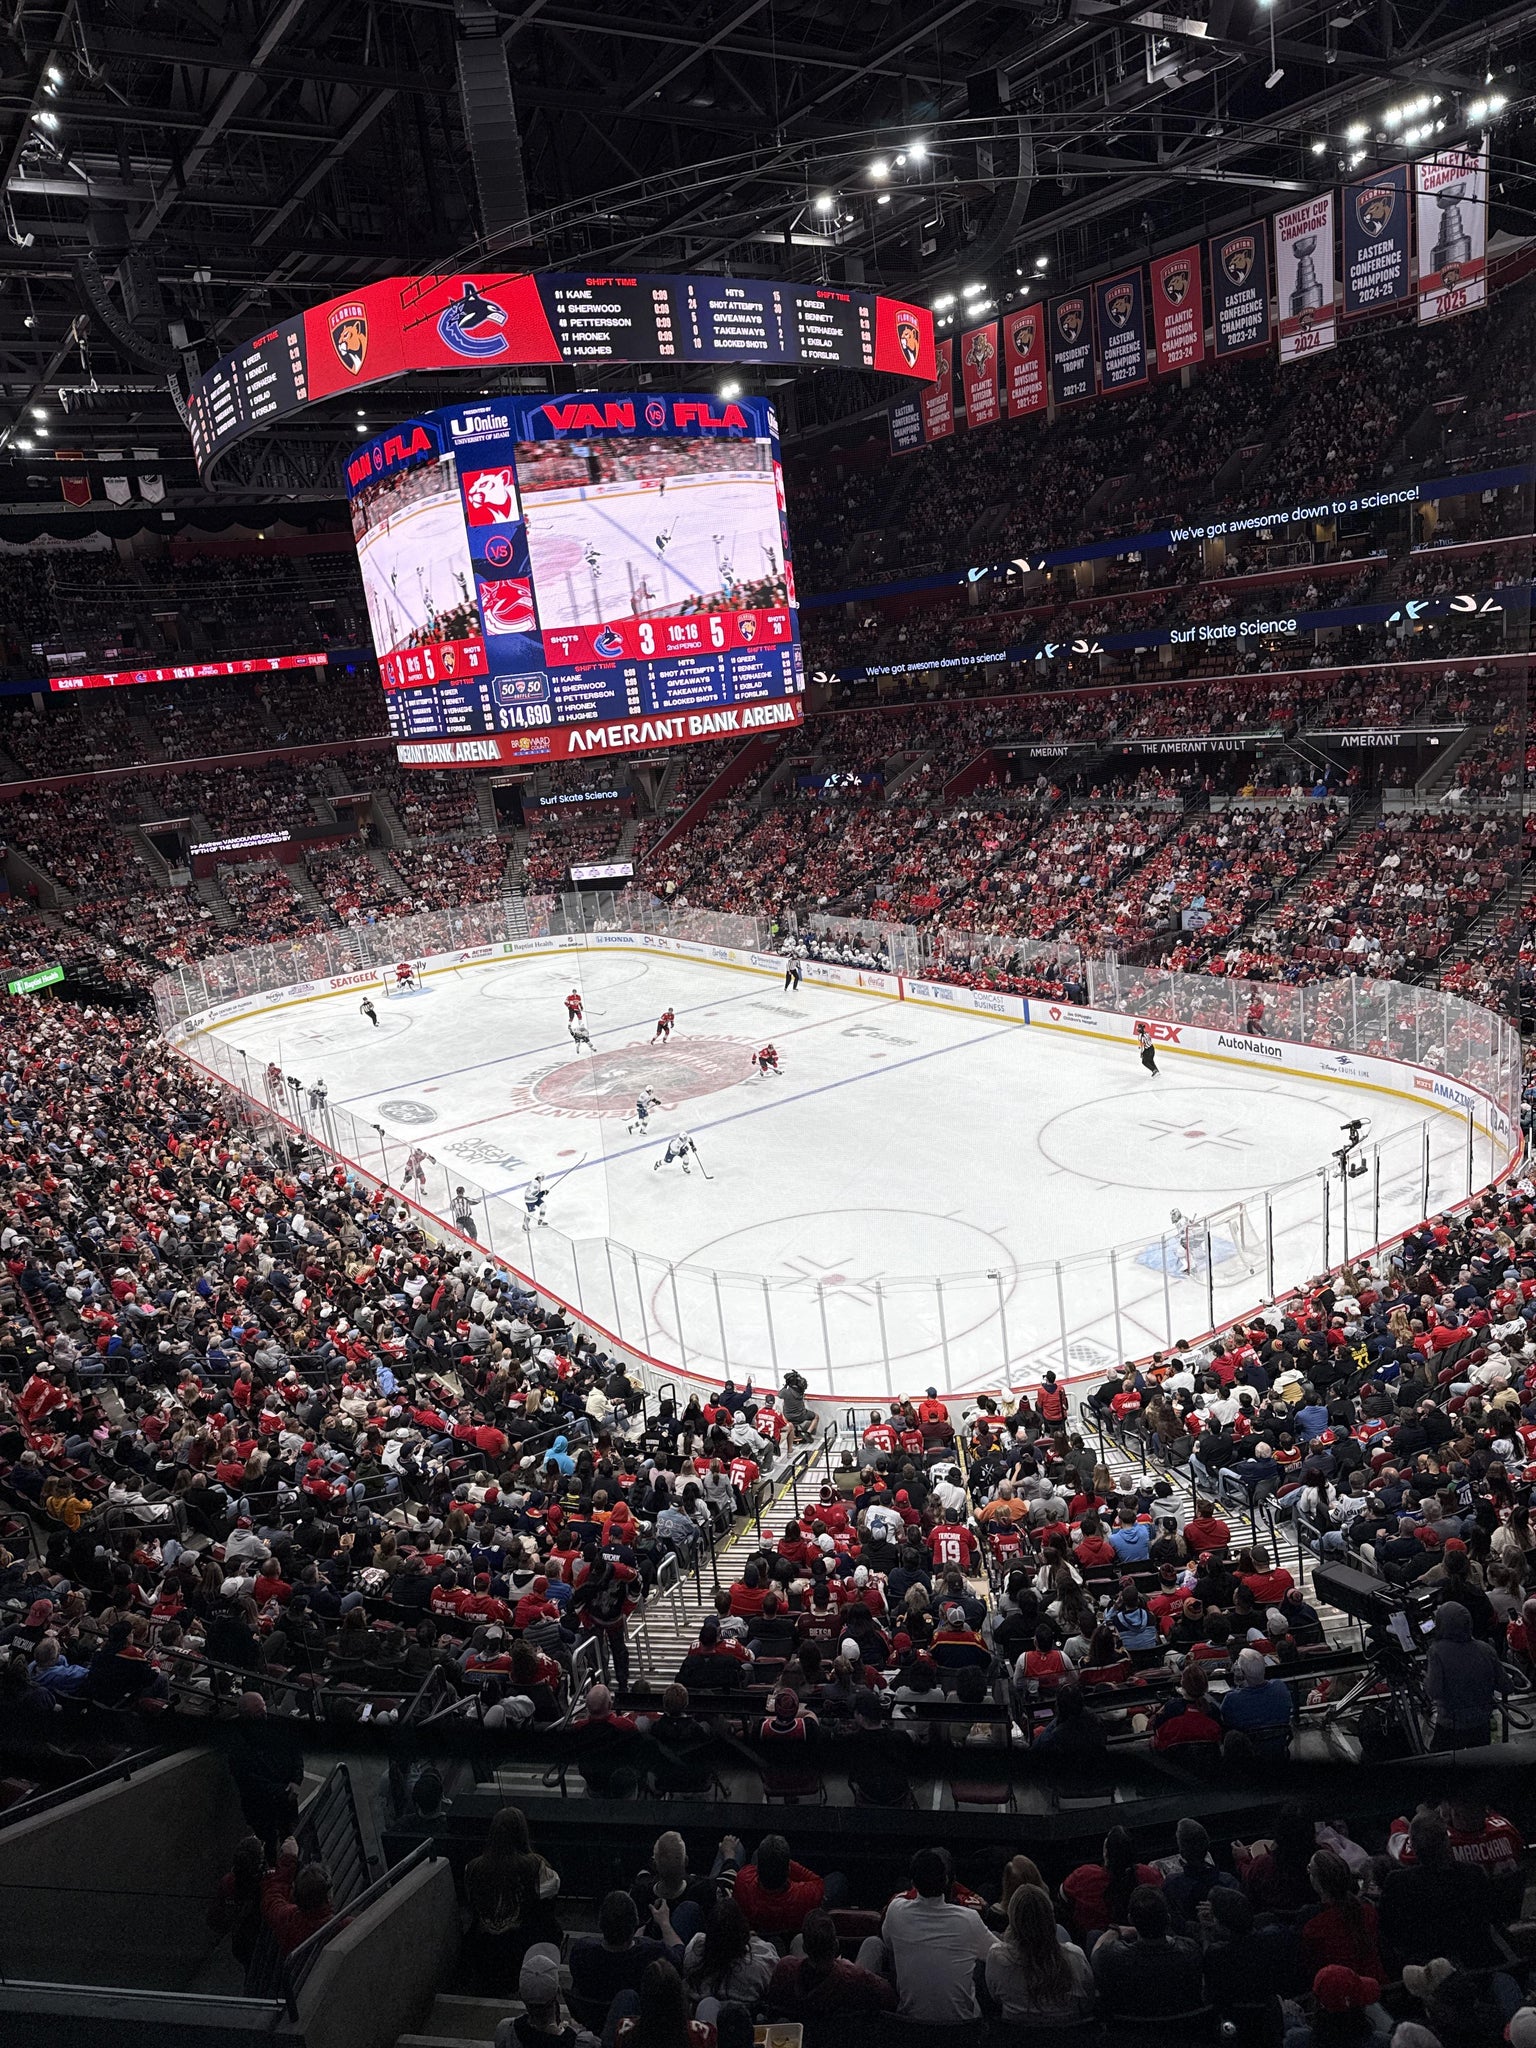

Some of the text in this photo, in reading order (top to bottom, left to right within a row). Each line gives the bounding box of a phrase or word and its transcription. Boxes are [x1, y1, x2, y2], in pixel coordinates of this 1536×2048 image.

[1279, 200, 1329, 229] STANLEY CUP
[1281, 214, 1327, 241] CHAMPIONS
[1357, 239, 1394, 262] EASTERN
[1350, 250, 1402, 278] CONFERENCE
[585, 278, 638, 287] SHIFT TIME
[1351, 265, 1401, 291] CHAMPIONS
[566, 290, 592, 299] KANE
[725, 288, 745, 298] HITS
[1225, 288, 1256, 308] EASTERN
[1359, 282, 1393, 303] 2024-25
[568, 304, 622, 313] SHERWOOD
[688, 298, 764, 311] 24 SHOT ATTEMPTS
[803, 299, 825, 310] GREER
[1436, 289, 1467, 315] 2025
[331, 306, 363, 327] FLORIDA
[691, 311, 763, 324] 5 GIVEAWAYS
[804, 312, 834, 323] BENNETT
[1164, 308, 1193, 327] ATLANTIC
[1219, 299, 1263, 322] CONFERENCE
[570, 318, 632, 327] PETTERSSON
[1165, 321, 1193, 339] DIVISION
[1221, 312, 1263, 334] CHAMPIONS
[561, 332, 610, 341] 17 HRONEK
[713, 326, 784, 339] TAKEAWAYS 2
[805, 325, 844, 336] VERHAEGHE
[1227, 327, 1257, 345] 2023-24
[713, 339, 768, 349] BLOCKED SHOTS
[1109, 330, 1135, 347] EASTERN
[1161, 332, 1198, 353] CHAMPIONS
[1294, 332, 1321, 354] 2024
[573, 346, 612, 355] HUGHES
[808, 350, 840, 360] FORSLING
[1104, 340, 1141, 360] CONFERENCE
[1168, 346, 1193, 363] 2023-24
[1013, 360, 1039, 376] ATLANTIC
[1062, 358, 1085, 374] TROPHY
[1106, 353, 1141, 371] CHAMPIONS
[1014, 372, 1038, 387] DIVISION
[1111, 366, 1136, 382] 2022-23
[1011, 381, 1043, 399] CHAMPIONS
[1063, 381, 1086, 397] 2021-22
[1017, 394, 1038, 409] 2021-22
[541, 402, 636, 430] VAN
[672, 402, 748, 428] FLA
[894, 404, 914, 417] EASTERN
[892, 412, 920, 428] CONFERENCE
[454, 434, 485, 445] UNIVERSITY
[493, 431, 510, 439] MIAMI
[348, 426, 432, 487] VAN FLA
[1170, 485, 1420, 542] We've got awesome down to a science!
[767, 615, 786, 623] SHOTS
[550, 634, 579, 644] SHOTS
[638, 616, 725, 655] 3 10:16 5
[1170, 618, 1297, 645] Surf Skate Science
[562, 643, 570, 656] 7
[666, 641, 702, 651] 2nd PERIOD
[423, 648, 435, 680] 5
[678, 658, 695, 667] HITS
[865, 650, 1007, 677] We've got awesome down to a science!
[155, 669, 163, 681] 3
[560, 674, 583, 683] KANE
[659, 665, 715, 679] SHOT ATTEMPTS
[501, 681, 541, 695] 50 50
[562, 681, 607, 693] SHERWOOD
[667, 675, 711, 687] GIVEAWAYS
[563, 690, 615, 702] PETTERSSON
[666, 685, 713, 697] TAKEAWAYS
[565, 702, 597, 712] HRONEK
[663, 693, 718, 707] BLOCKED SHOTS
[499, 704, 552, 729] $14,690
[566, 711, 599, 721] HUGHES
[567, 701, 795, 754] AMERANT BANK ARENA
[1141, 739, 1247, 754] THE AMERANT VAULT
[1340, 734, 1402, 747] AMERANT
[425, 739, 502, 763] BANK ARENA
[1029, 746, 1069, 757] AMERANT
[540, 789, 618, 806] Surf Skate Science
[222, 834, 260, 845] VANCOUVER
[231, 841, 258, 849] SEASON
[513, 942, 534, 951] Baptist
[534, 940, 554, 949] Health
[23, 971, 59, 990] Baptist Health
[330, 970, 379, 990] SEATGEEK
[973, 991, 1004, 1005] COMCAST
[974, 1000, 1005, 1013] BUSINESS
[1217, 1035, 1282, 1057] AutoNation
[1433, 1083, 1476, 1111] AMAZING
[939, 1540, 961, 1563] 19
[1452, 1836, 1513, 1861] MARCHAND
